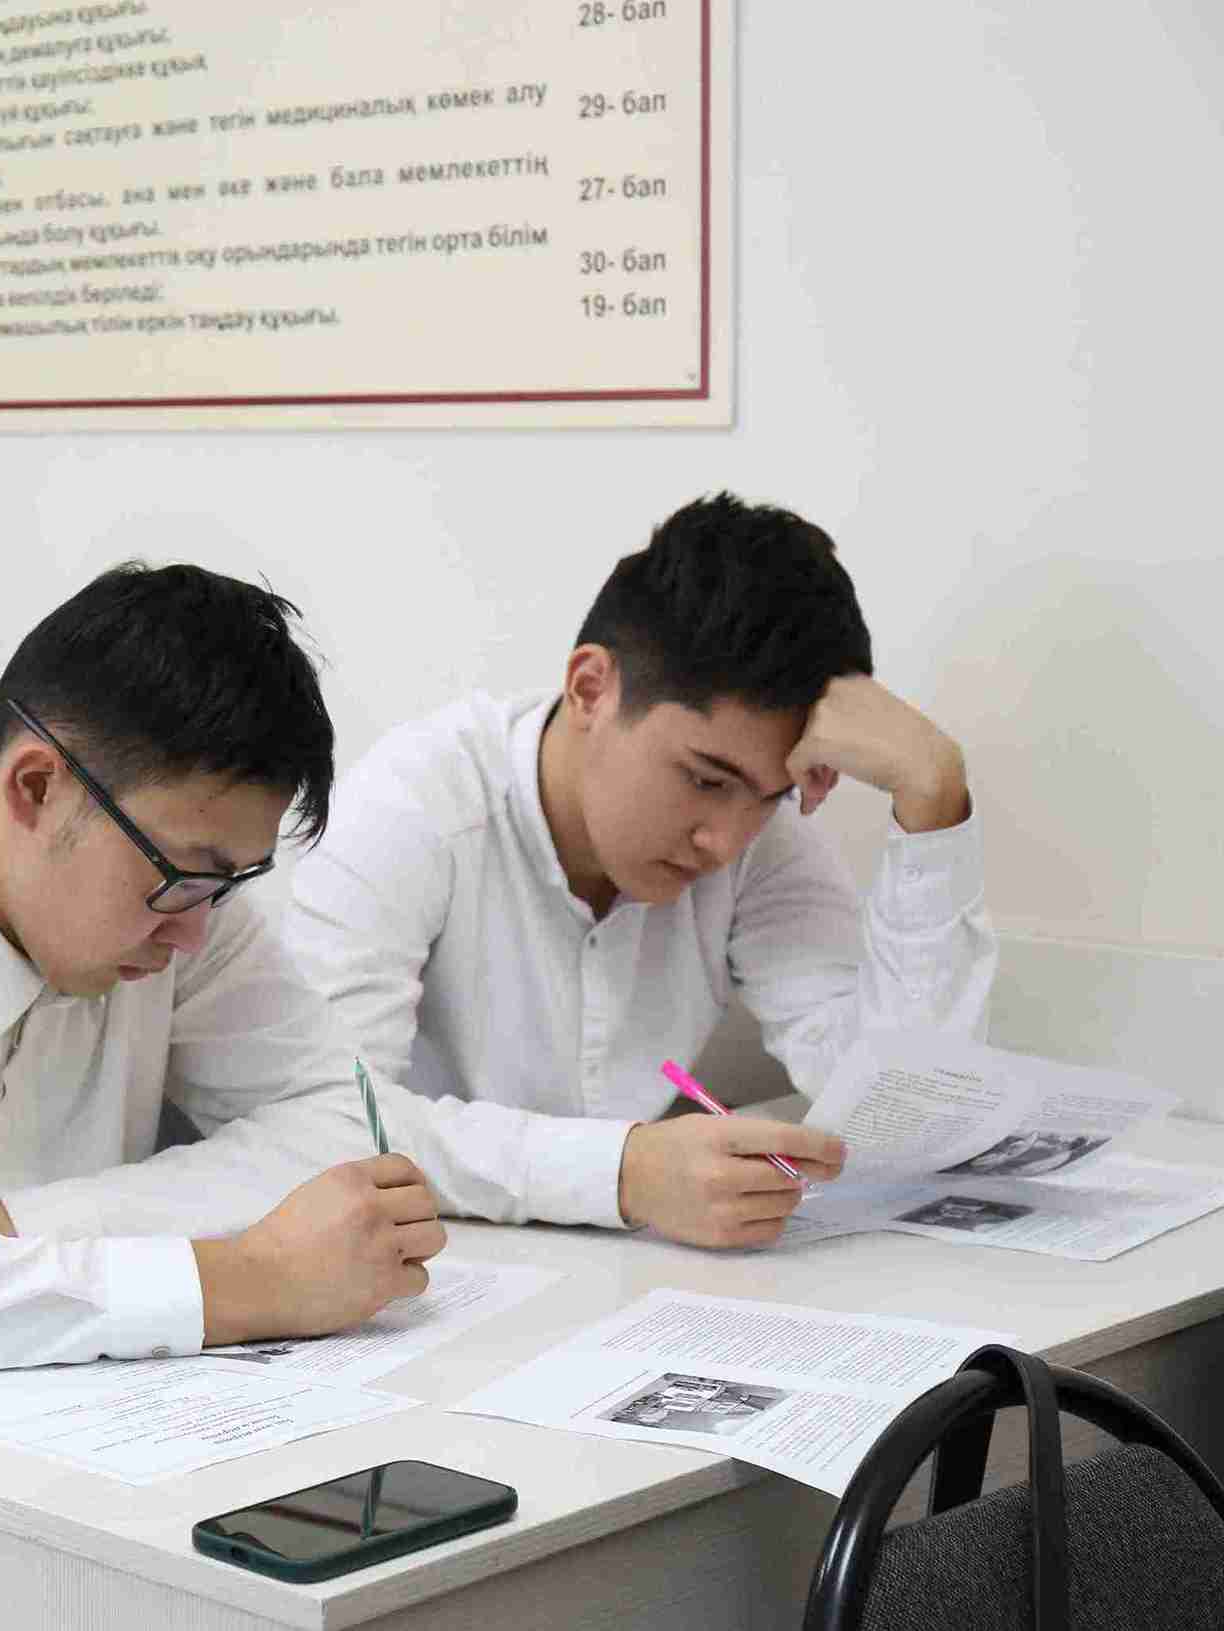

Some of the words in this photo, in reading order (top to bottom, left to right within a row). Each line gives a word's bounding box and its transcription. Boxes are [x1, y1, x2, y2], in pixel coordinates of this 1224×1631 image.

[578, 1, 615, 27] 28-
[621, 0, 667, 21] бап
[266, 97, 417, 126] медициналық
[426, 89, 495, 111] көмек
[506, 82, 547, 106] алу
[578, 92, 615, 119] 29-
[621, 89, 667, 115] бап
[329, 163, 385, 191] бала
[397, 150, 550, 184] мемлекеттің
[578, 175, 615, 202] 27-
[621, 172, 667, 198] бап
[376, 229, 427, 255] тегін
[432, 230, 483, 255] орта
[487, 220, 548, 249] білім
[579, 250, 615, 276] 30-
[622, 245, 667, 273] бап
[580, 294, 615, 319] 19-
[622, 291, 667, 318] бап
